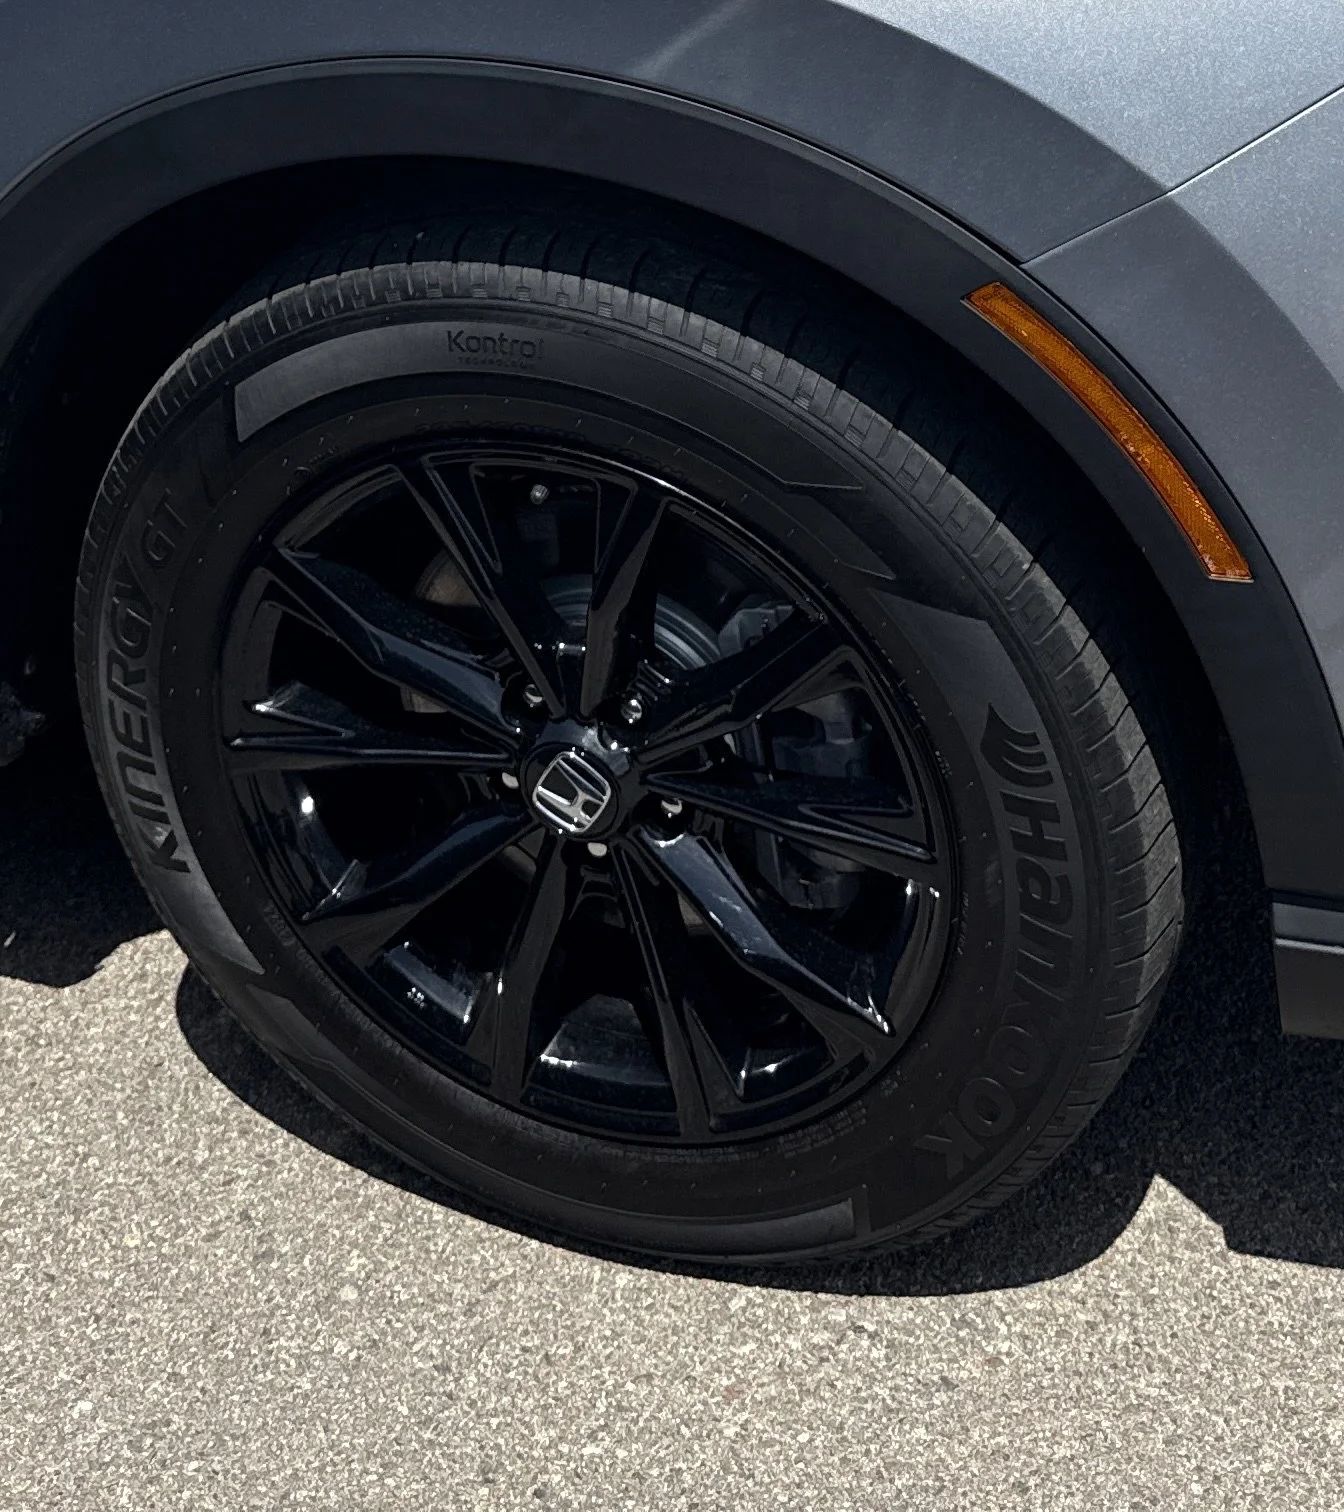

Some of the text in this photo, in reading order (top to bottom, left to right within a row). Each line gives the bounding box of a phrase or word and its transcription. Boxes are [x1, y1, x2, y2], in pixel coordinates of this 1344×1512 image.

[446, 329, 546, 359] Kontrol
[106, 487, 192, 873] KINERGY GT
[913, 790, 1074, 1181] Hankook
